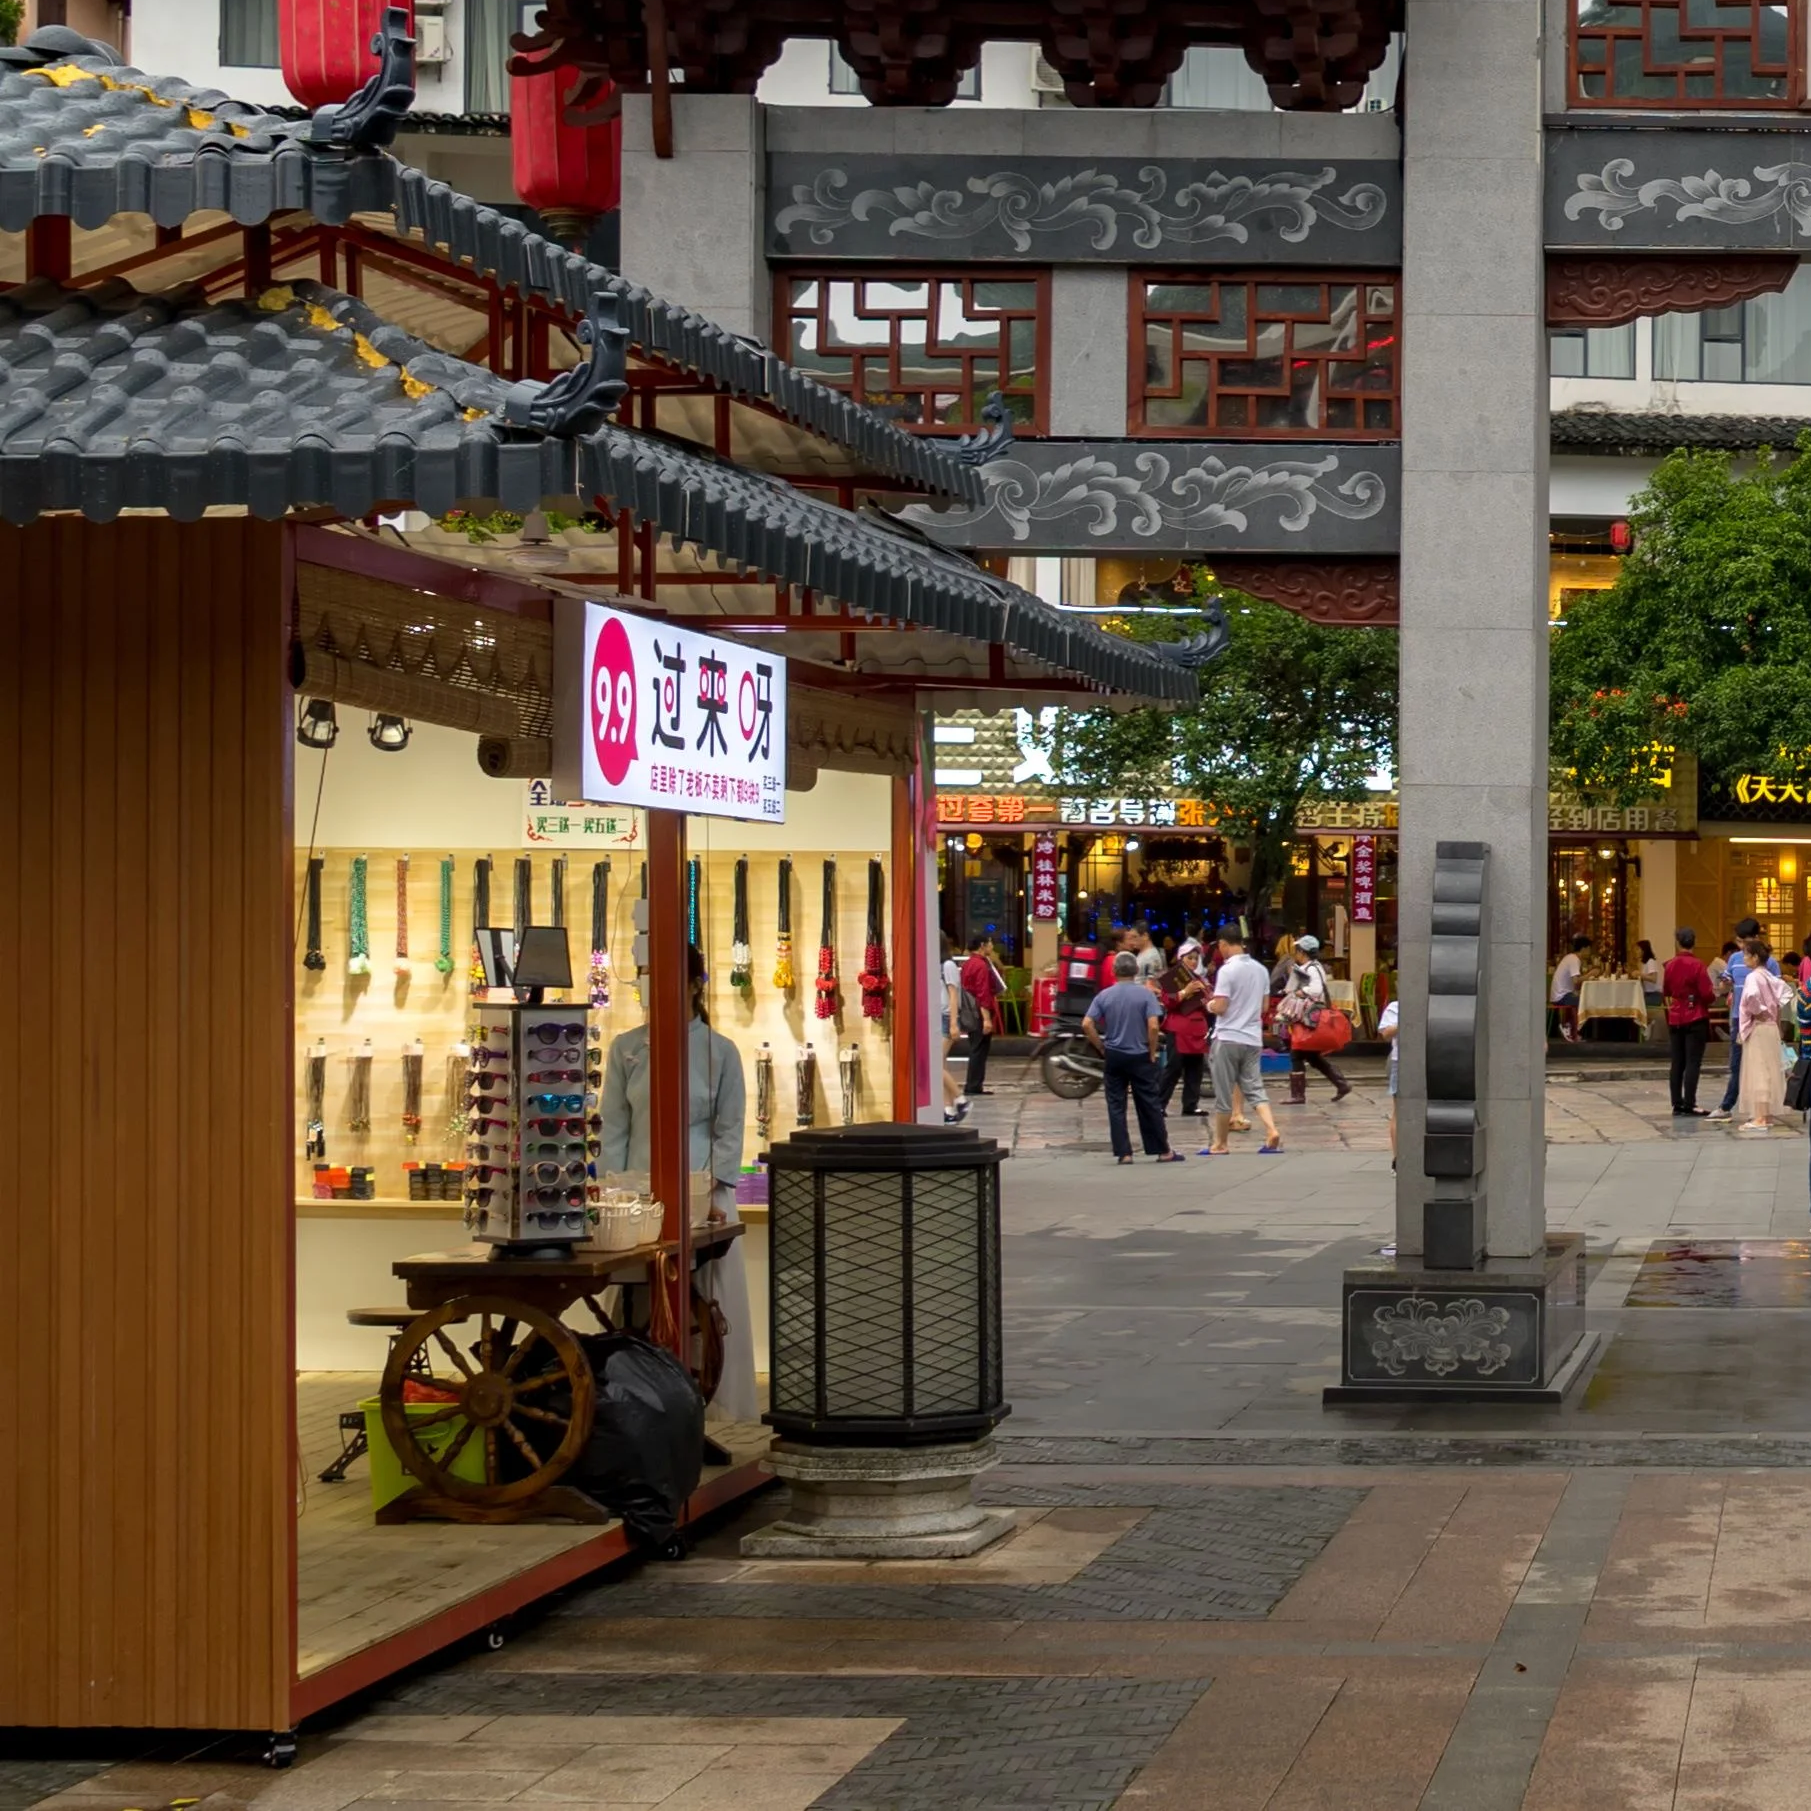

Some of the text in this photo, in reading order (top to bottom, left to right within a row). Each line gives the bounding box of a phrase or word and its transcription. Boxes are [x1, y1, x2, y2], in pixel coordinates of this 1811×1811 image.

[595, 666, 634, 745] 9.9
[651, 638, 773, 763] 过来呀
